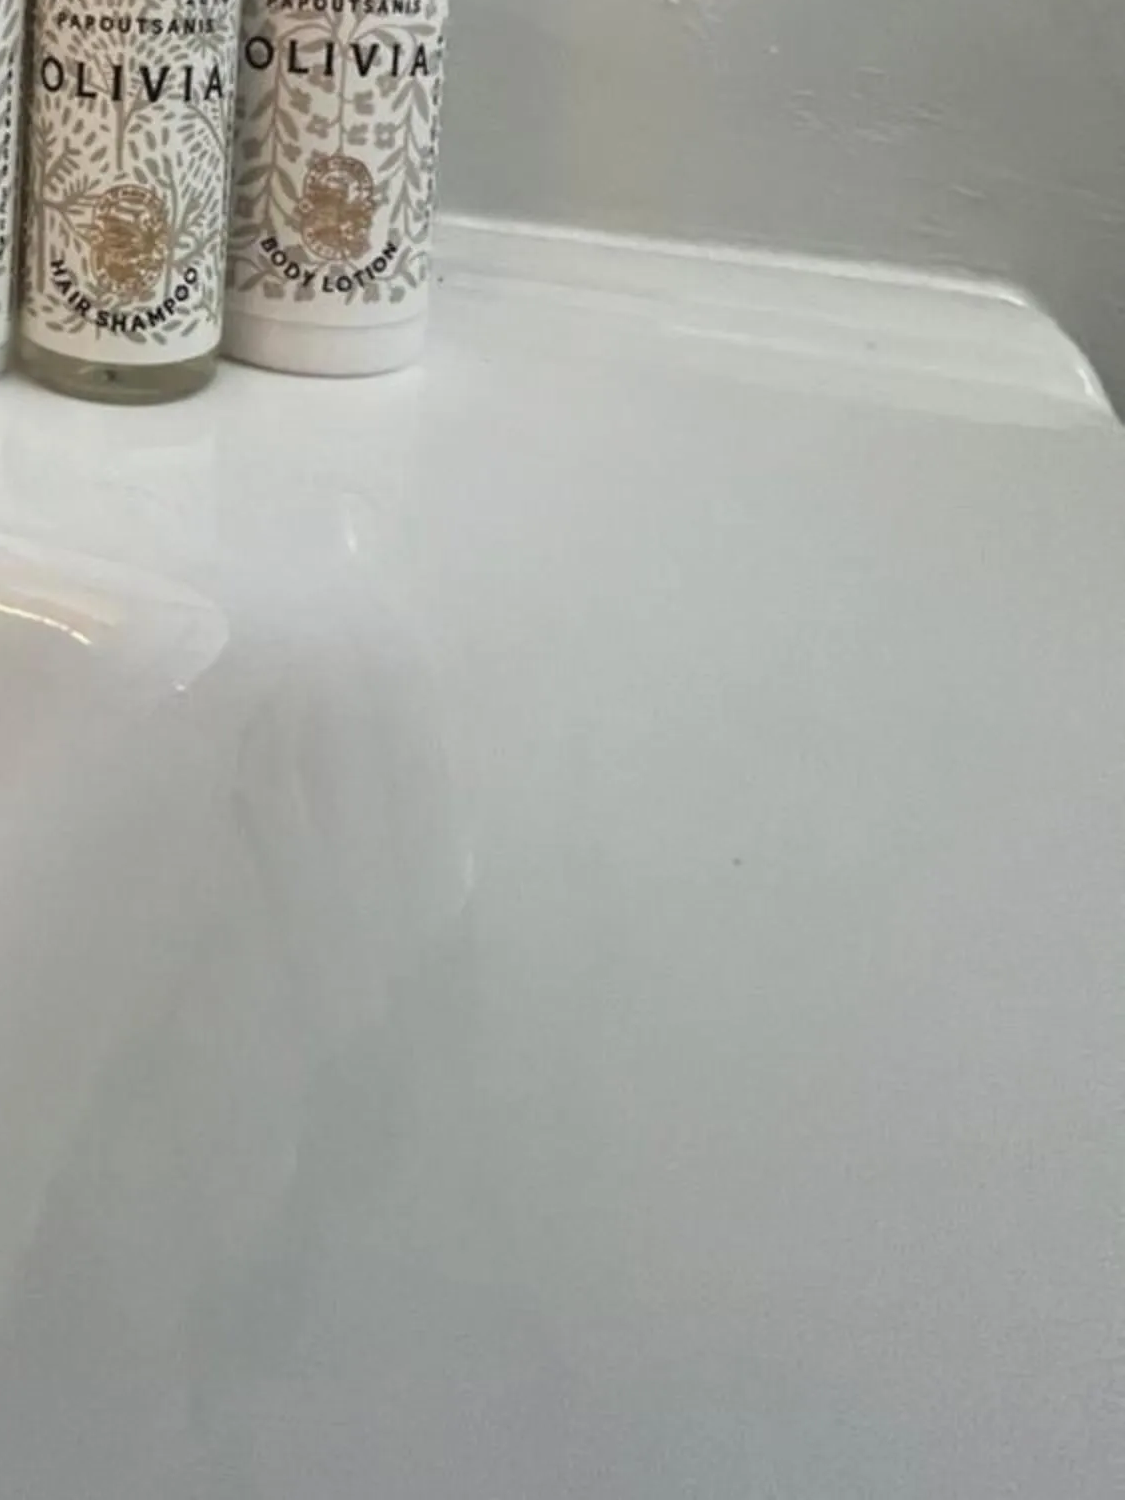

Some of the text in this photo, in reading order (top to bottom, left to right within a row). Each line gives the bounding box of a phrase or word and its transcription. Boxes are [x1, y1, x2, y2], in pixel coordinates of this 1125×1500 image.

[56, 10, 214, 35] PAPOUTSANIS
[41, 56, 223, 102] OLIVIA
[245, 36, 429, 77] OLIVIA
[260, 235, 399, 293] BODY LOTION
[50, 259, 199, 333] HAIR SHAMPOO
